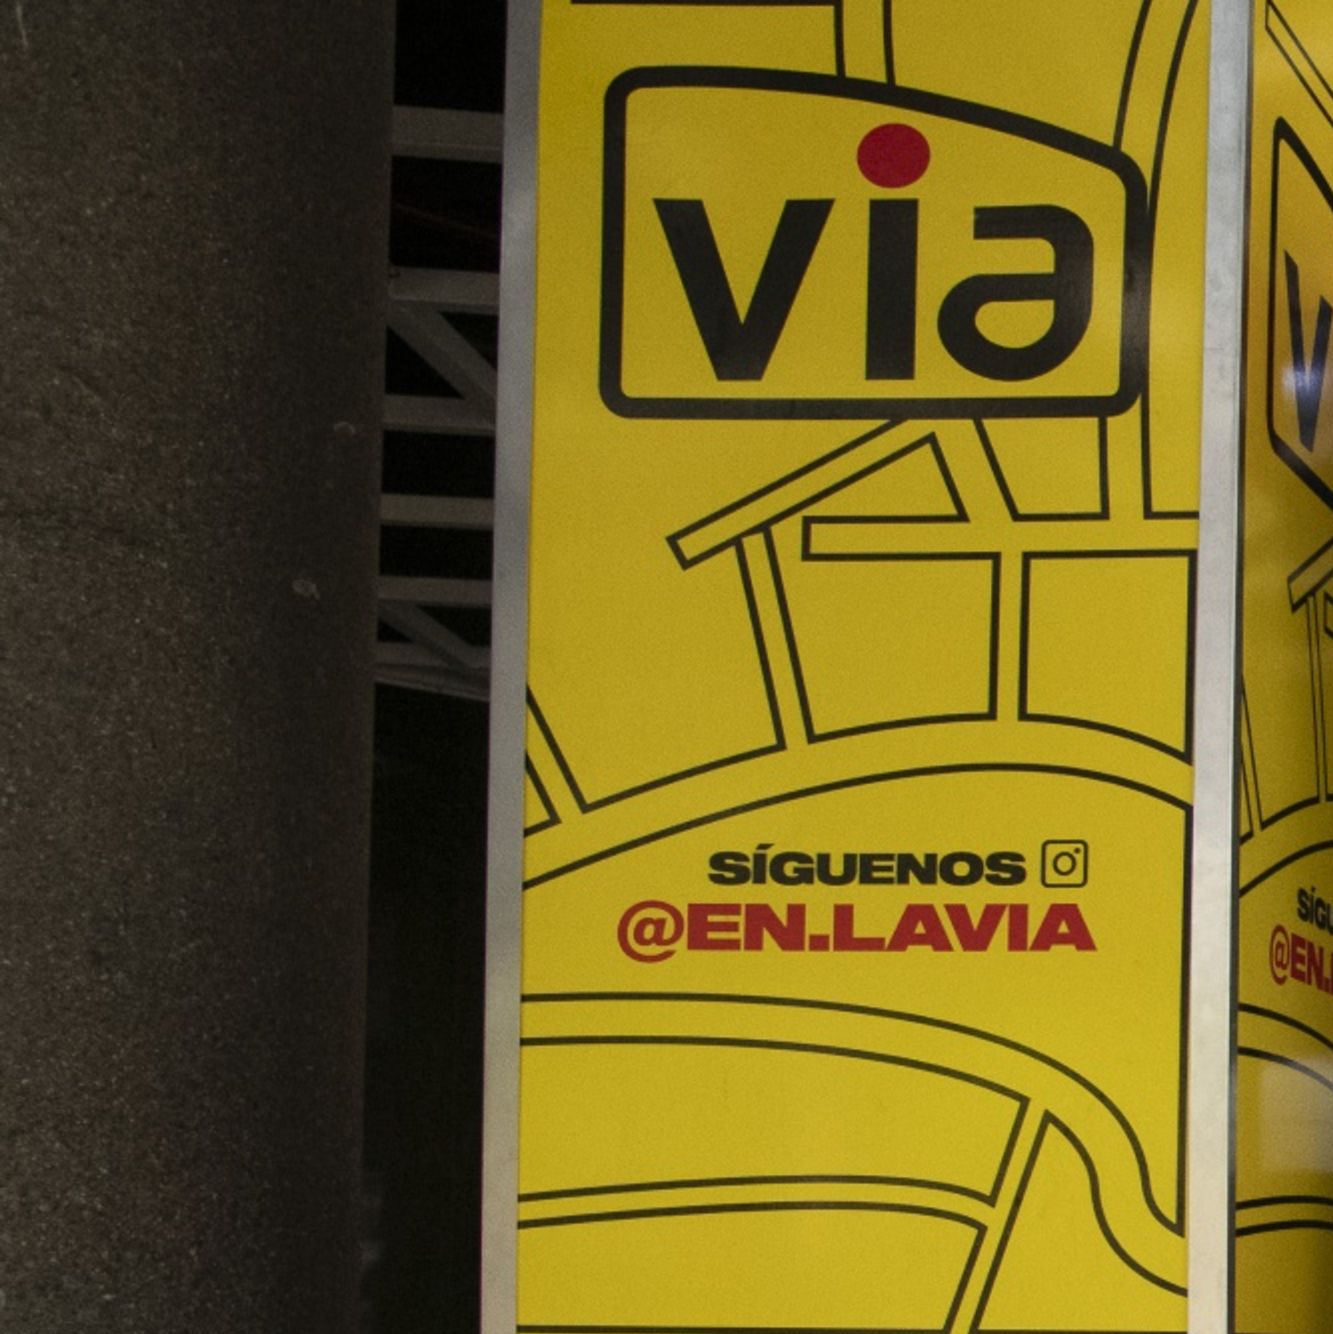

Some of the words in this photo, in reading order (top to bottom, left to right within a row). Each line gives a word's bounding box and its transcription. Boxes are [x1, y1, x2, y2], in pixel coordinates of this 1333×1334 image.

[652, 123, 1095, 381] via
[707, 843, 1026, 886] SÍGUENOS
[617, 900, 1098, 963] @EN.LAVIA
